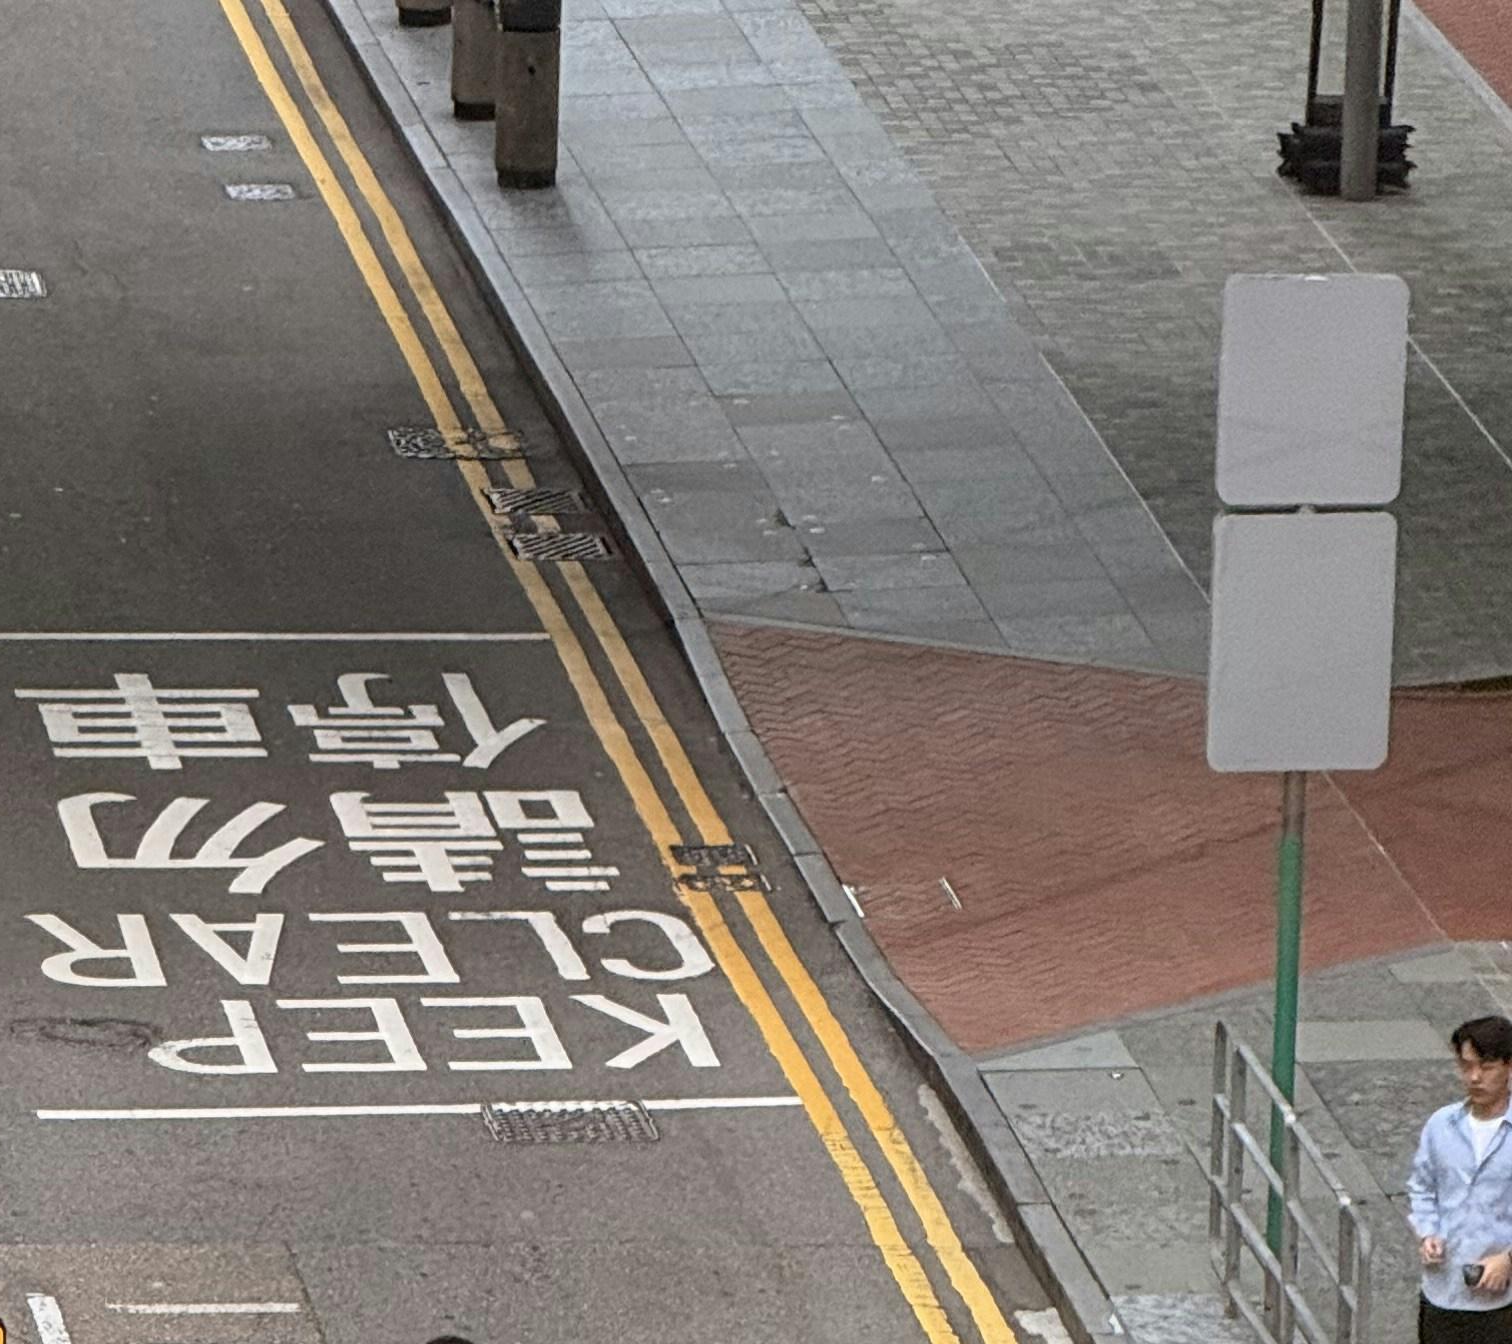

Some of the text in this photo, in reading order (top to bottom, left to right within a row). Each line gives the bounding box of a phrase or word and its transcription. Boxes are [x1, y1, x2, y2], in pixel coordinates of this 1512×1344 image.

[14, 672, 547, 770] 停車
[57, 790, 619, 893] 請勿
[24, 910, 715, 988] CLEAR
[147, 993, 721, 1074] KEEP
